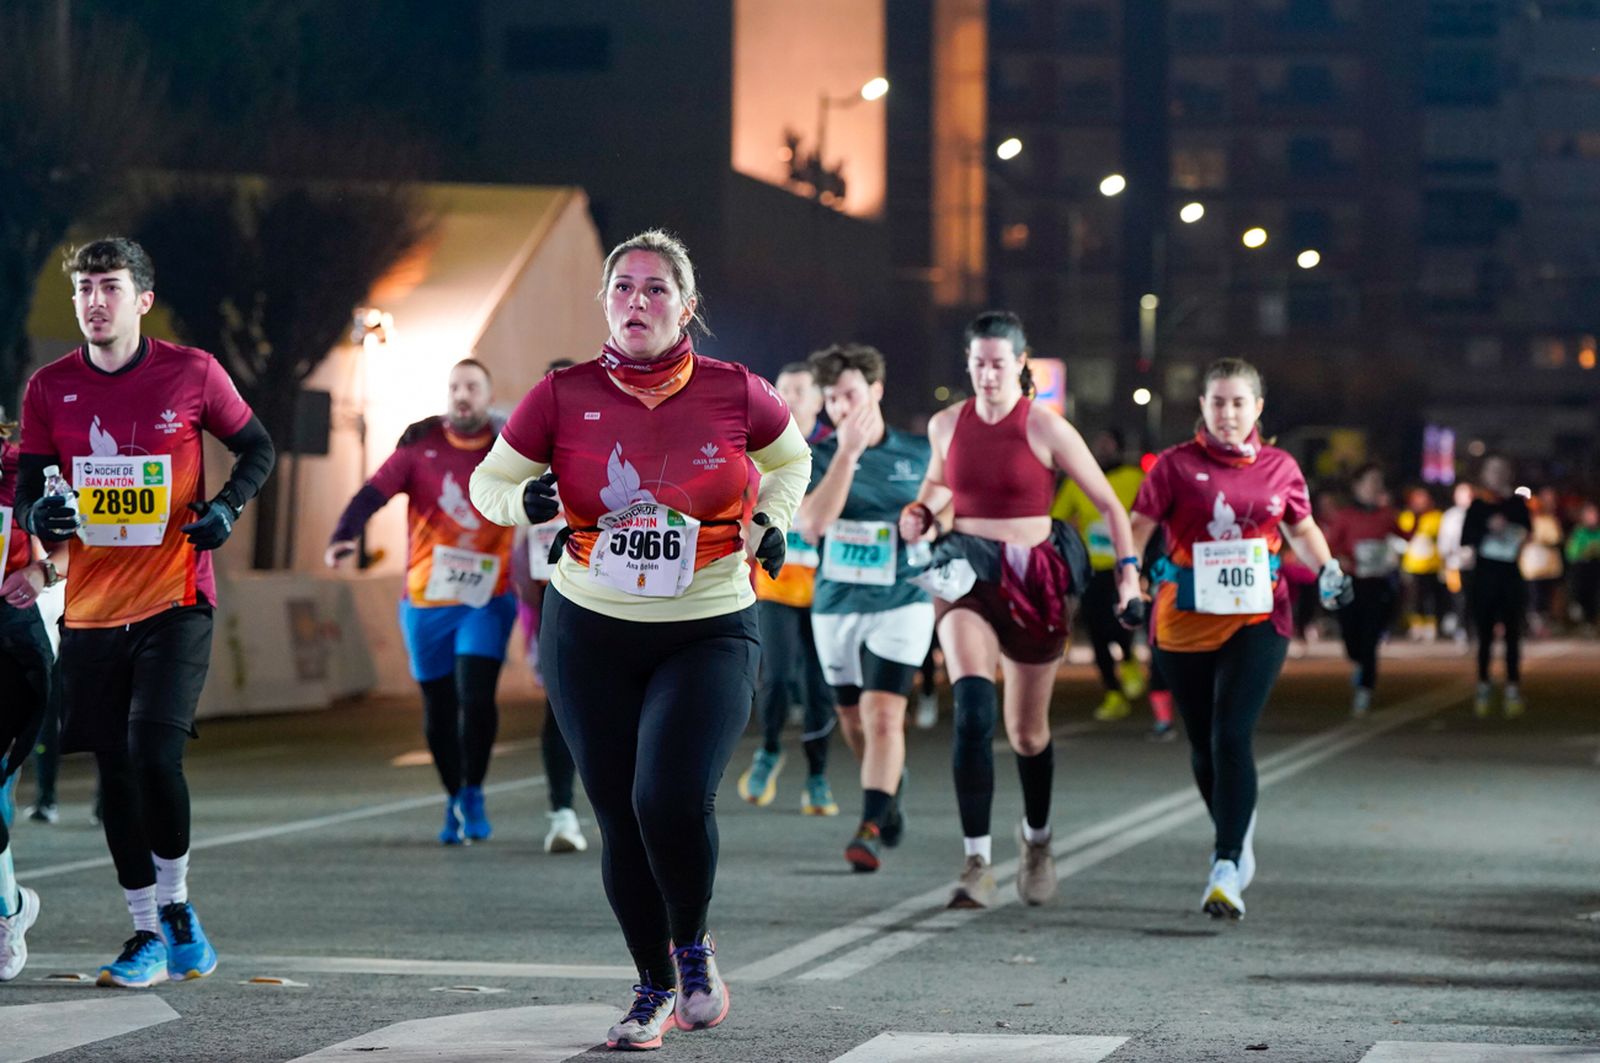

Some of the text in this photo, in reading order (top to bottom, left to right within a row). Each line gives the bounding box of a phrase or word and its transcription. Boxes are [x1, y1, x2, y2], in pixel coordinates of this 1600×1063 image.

[94, 466, 121, 476] NOCHE
[122, 466, 134, 476] DE
[84, 478, 103, 487] SAN
[92, 488, 155, 515] 2890
[609, 528, 682, 561] 5966
[625, 561, 639, 571] Ana
[1217, 567, 1255, 587] 406
